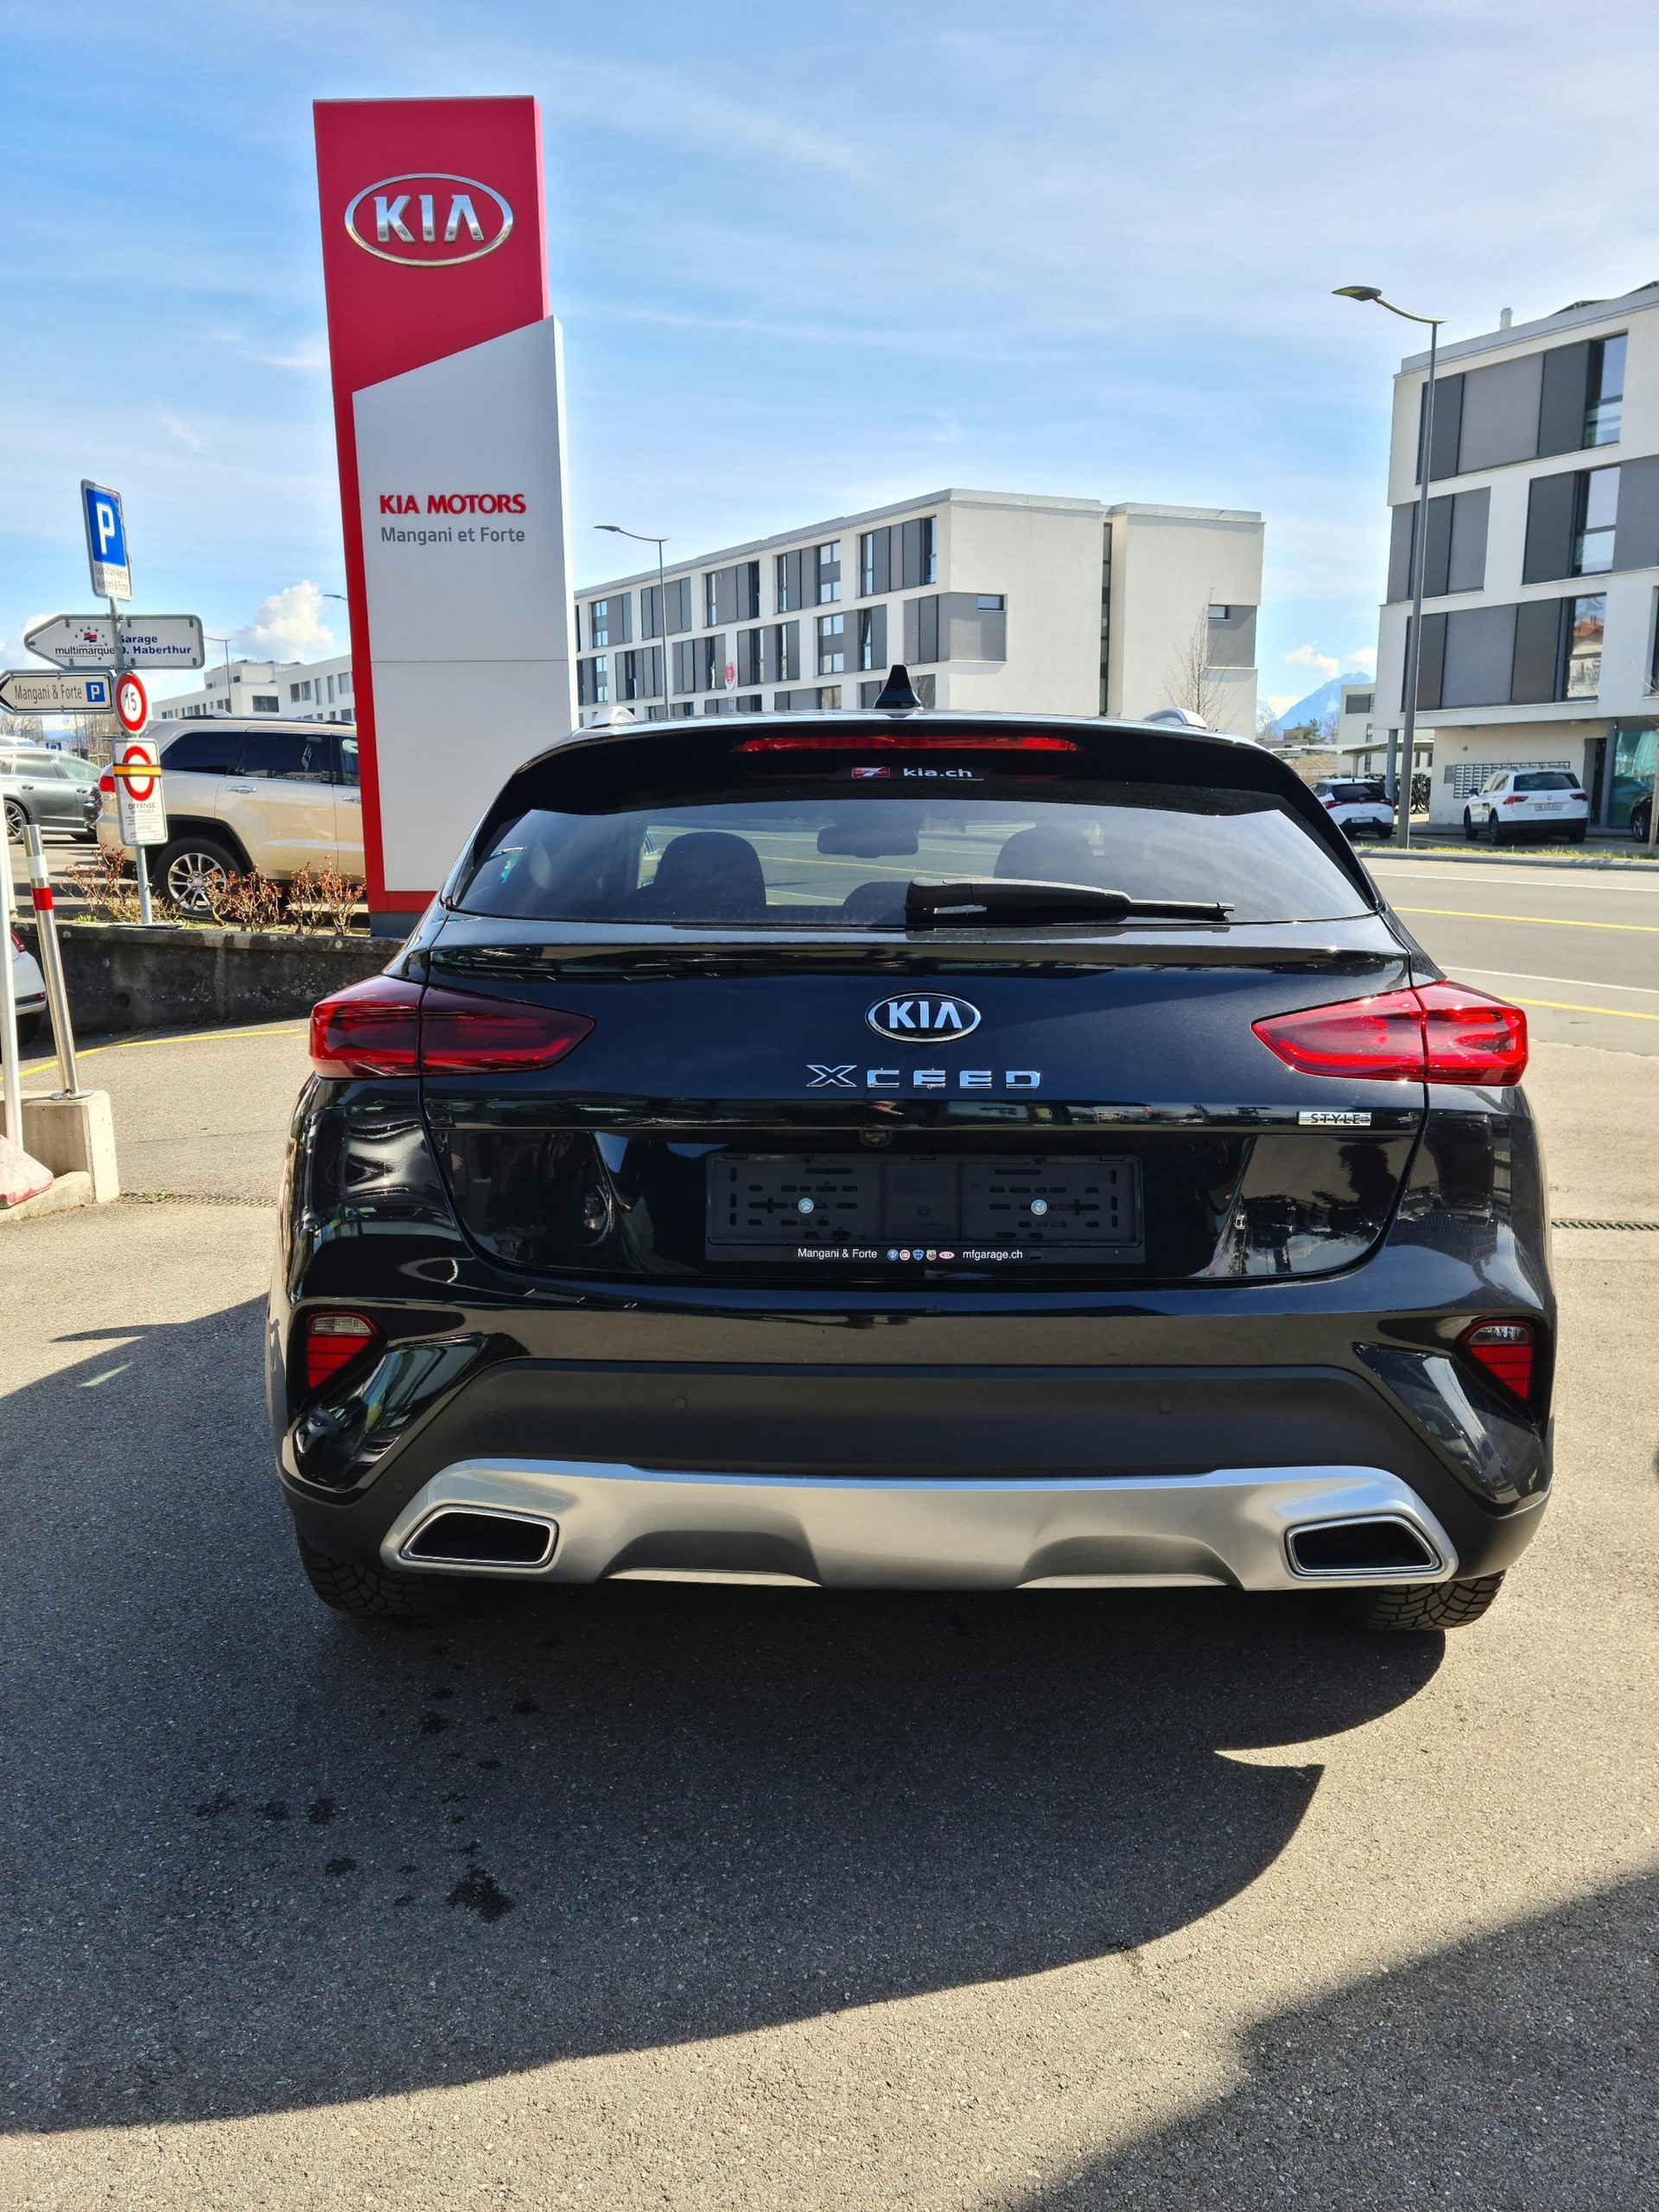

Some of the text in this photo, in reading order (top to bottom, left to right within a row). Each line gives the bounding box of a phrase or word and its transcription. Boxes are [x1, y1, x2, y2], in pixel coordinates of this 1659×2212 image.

[373, 194, 485, 243] KIA
[379, 493, 526, 514] KIA MOTORS
[96, 502, 115, 556] P
[381, 527, 525, 546] Mangani et Forte
[54, 645, 115, 658] multimarque
[133, 645, 192, 655] Haberthur
[14, 684, 100, 704] Mangani & Forte P
[124, 691, 137, 712] 15
[903, 767, 972, 778] kia.ch
[887, 1001, 963, 1029] KIA
[805, 1064, 1041, 1090] XCEED
[1310, 1113, 1361, 1125] STYLE
[798, 1248, 839, 1260] Mangani
[842, 1249, 849, 1258] &
[852, 1249, 878, 1259] Forte
[963, 1249, 1023, 1262] mfgarage.ch
